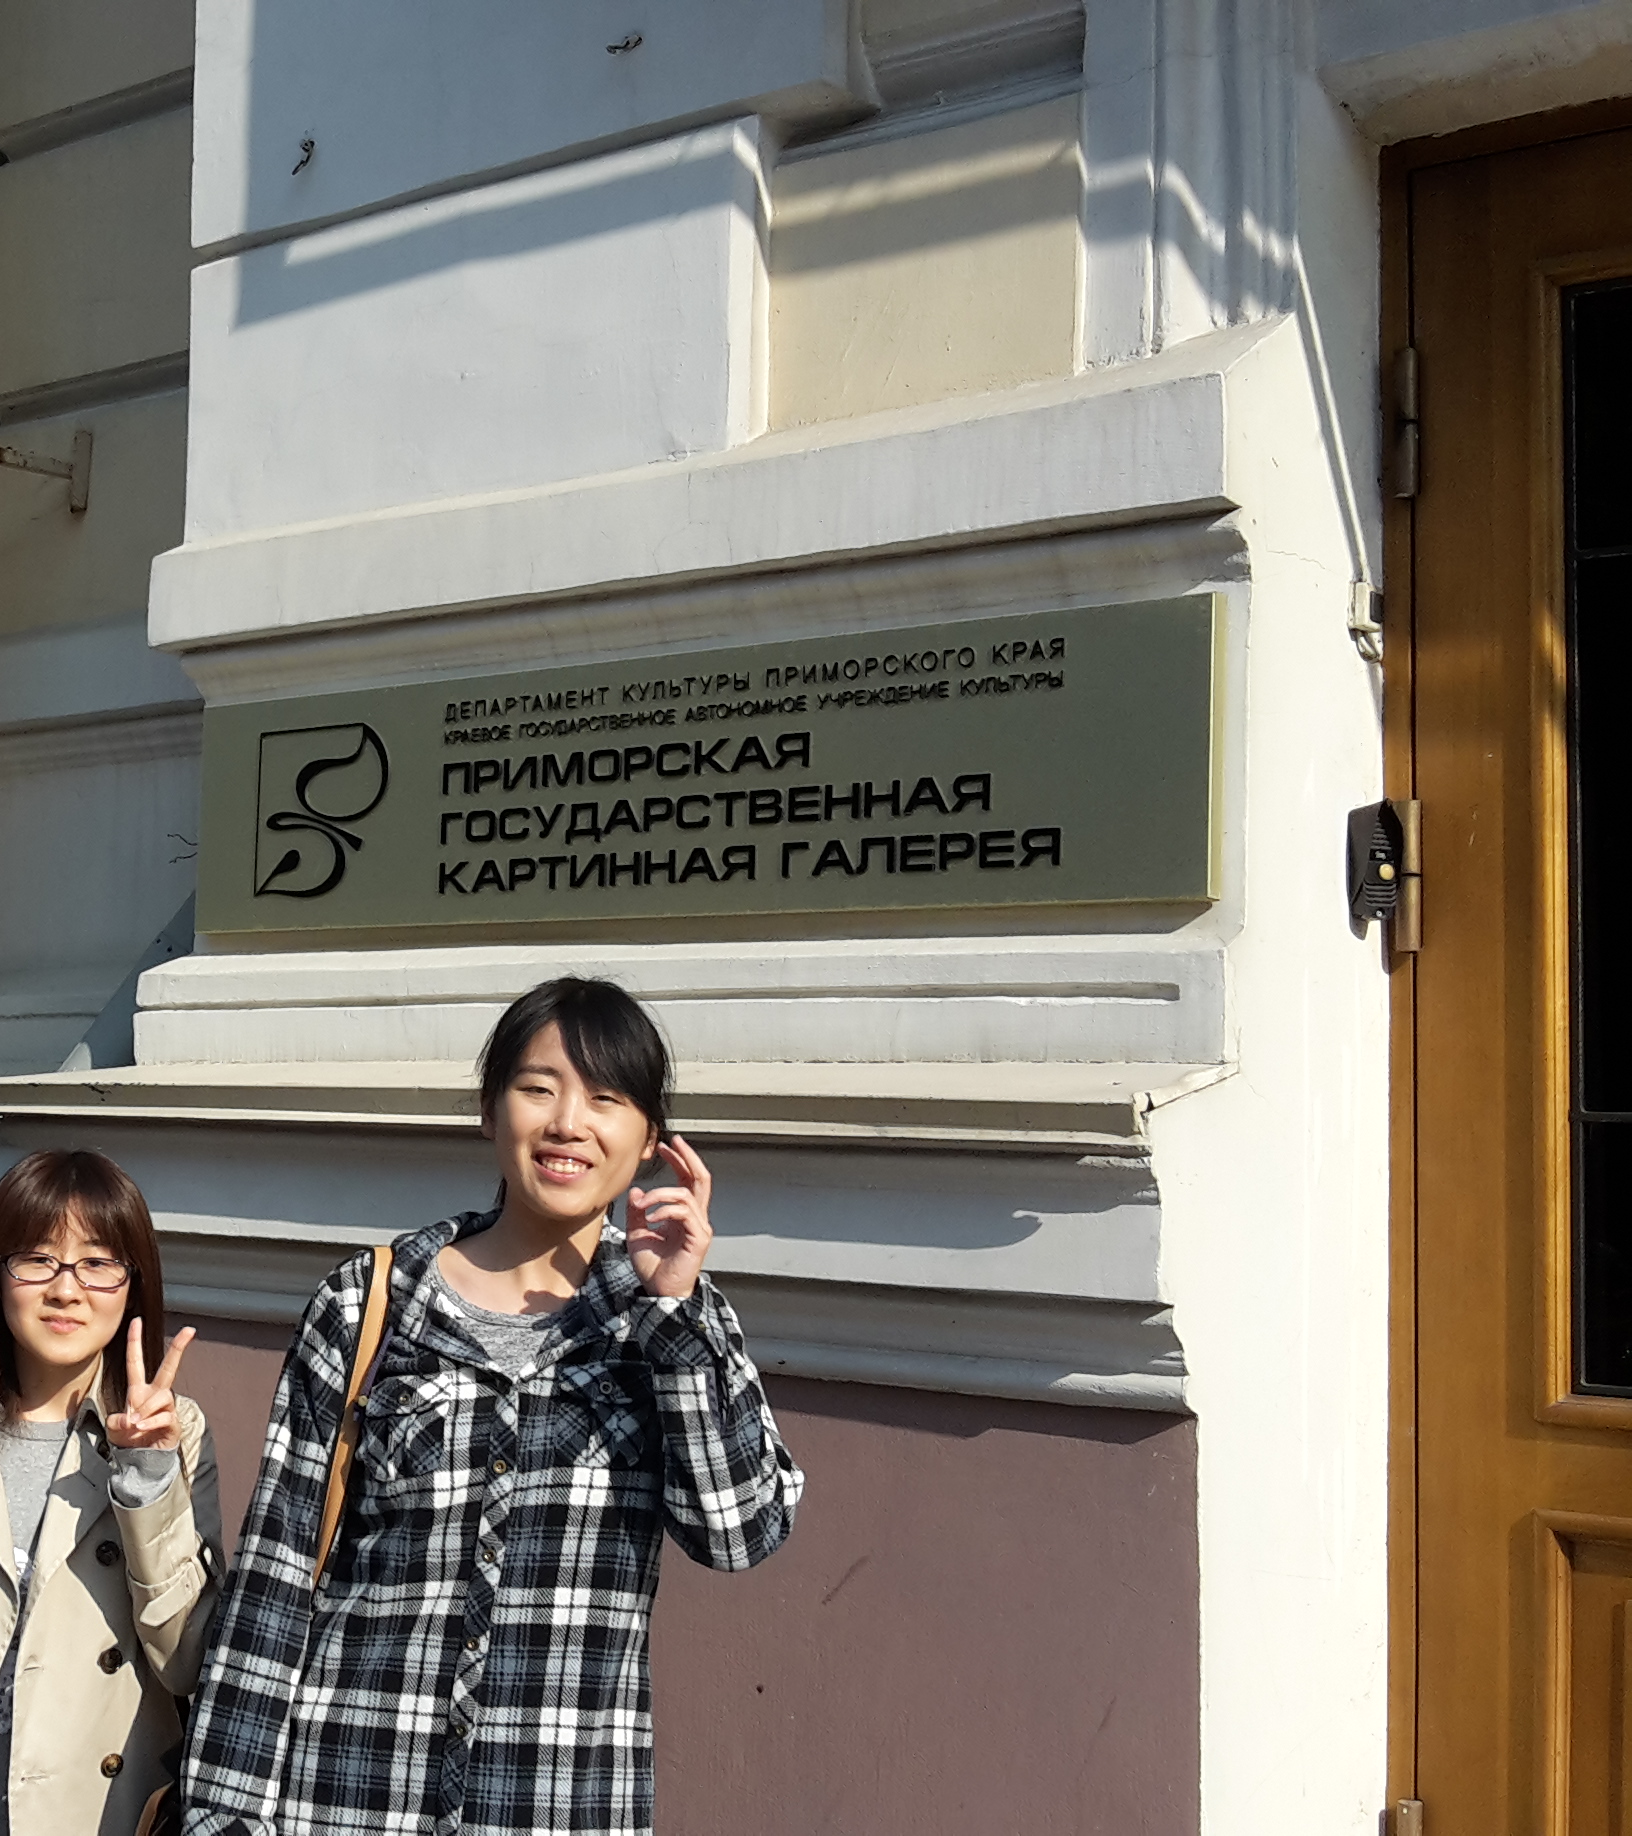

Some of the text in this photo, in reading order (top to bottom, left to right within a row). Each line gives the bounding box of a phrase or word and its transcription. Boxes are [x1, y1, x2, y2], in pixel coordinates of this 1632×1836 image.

[443, 670, 1065, 746] КРАЕВОЕ ГОСУДАРСТВЕННОЕ АВТОНОМНОЕ УЧРЕЖДЕНИЕ КУЛЬТУРЫ
[444, 637, 1066, 724] ДЕПАРТАМЕНТ КУЛЬТУРЫ ПРИМОРСКОГО КРАЯ
[441, 731, 811, 796] ПРИМОРСКАЯ
[439, 772, 993, 846] ГОСУДАРСТВЕННАЯ
[438, 826, 1063, 895] КАРТИННАЯ ГАЛЕРЕЯ
